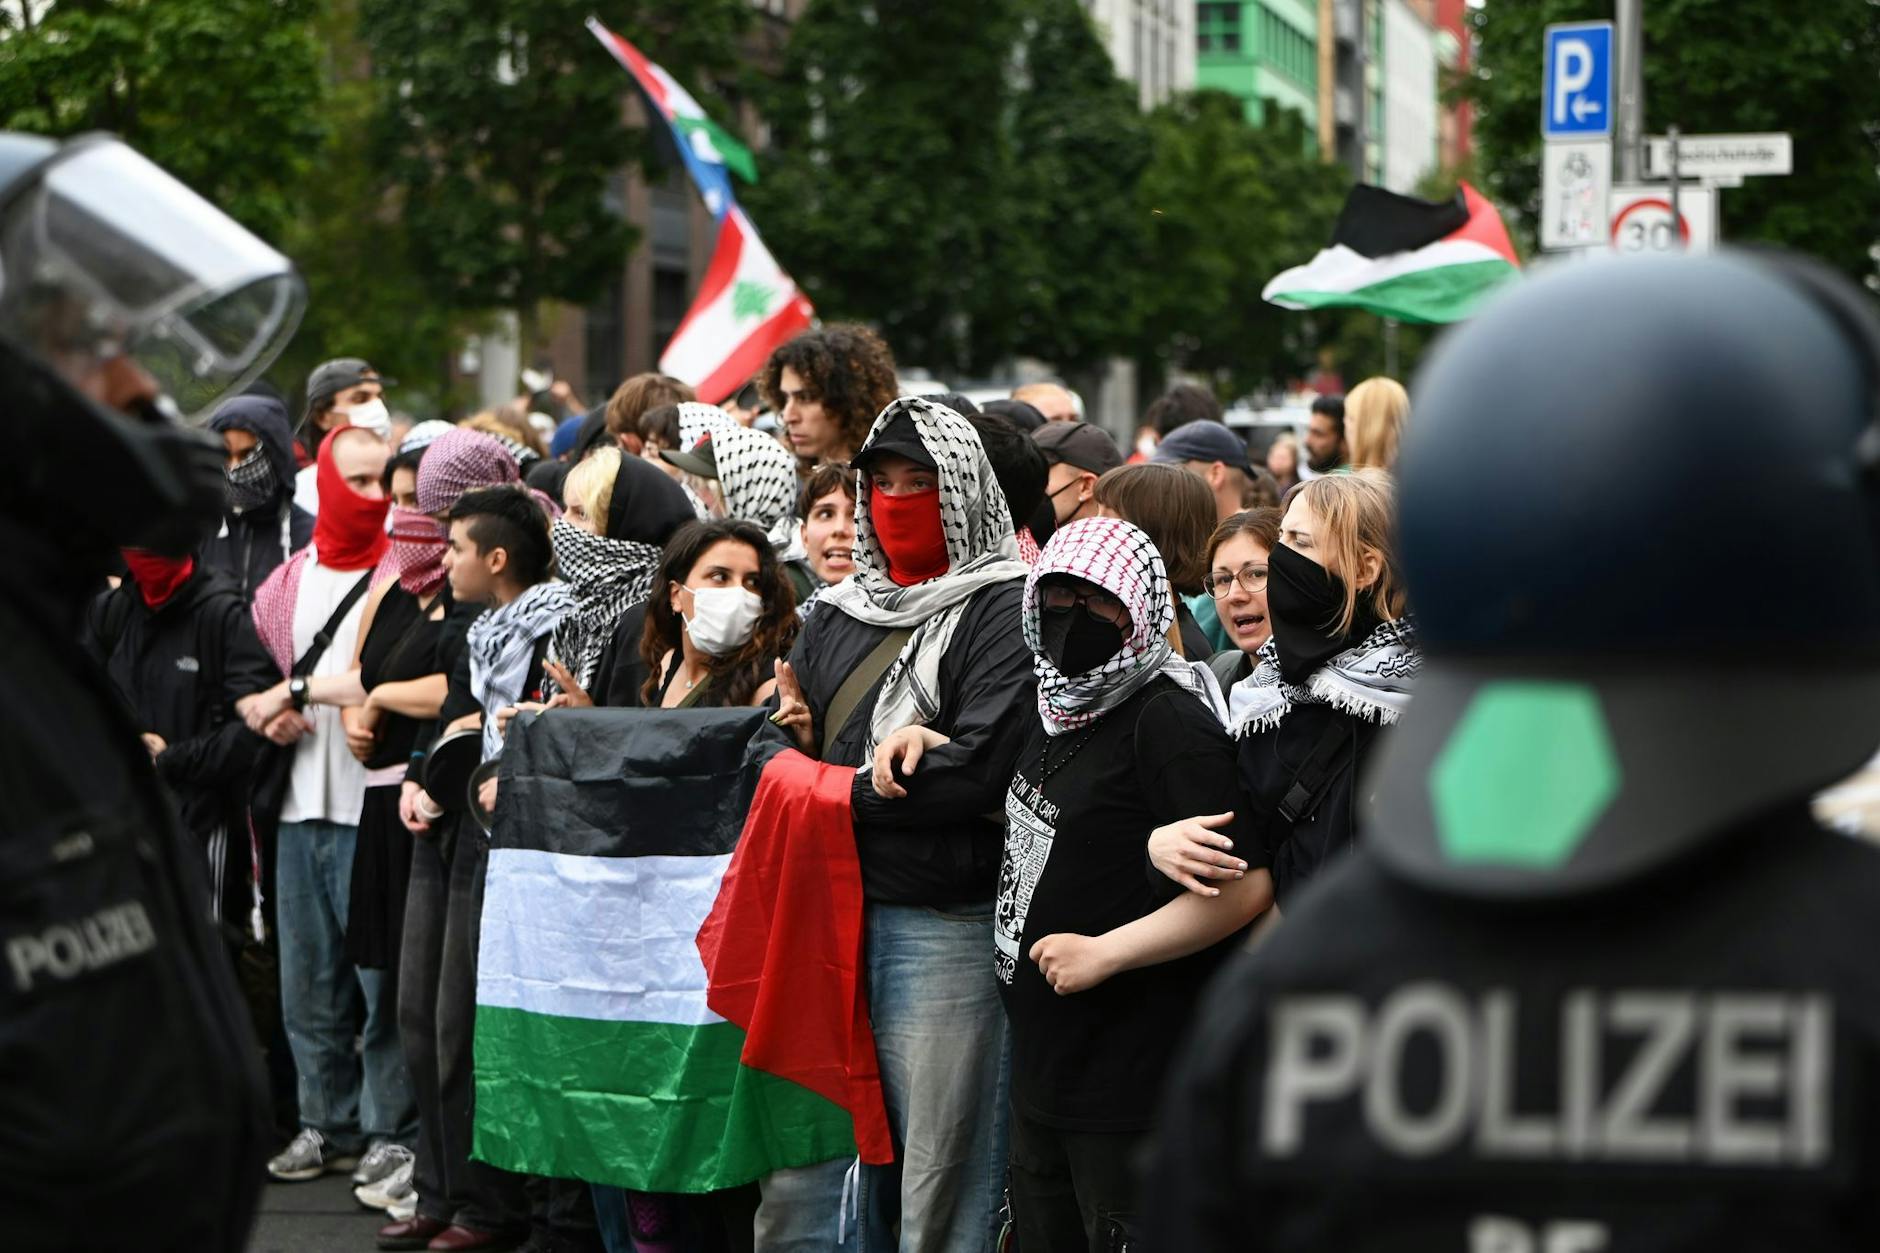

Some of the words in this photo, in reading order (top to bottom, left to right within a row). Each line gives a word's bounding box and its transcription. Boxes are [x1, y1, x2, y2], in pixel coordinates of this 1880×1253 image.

[1553, 38, 1595, 125] P
[1015, 779, 1031, 797] IN
[1039, 799, 1060, 825] CAR!
[7, 901, 156, 989] POLIZEI
[1001, 954, 1015, 972] TO
[1262, 983, 1832, 1164] POLIZEI
